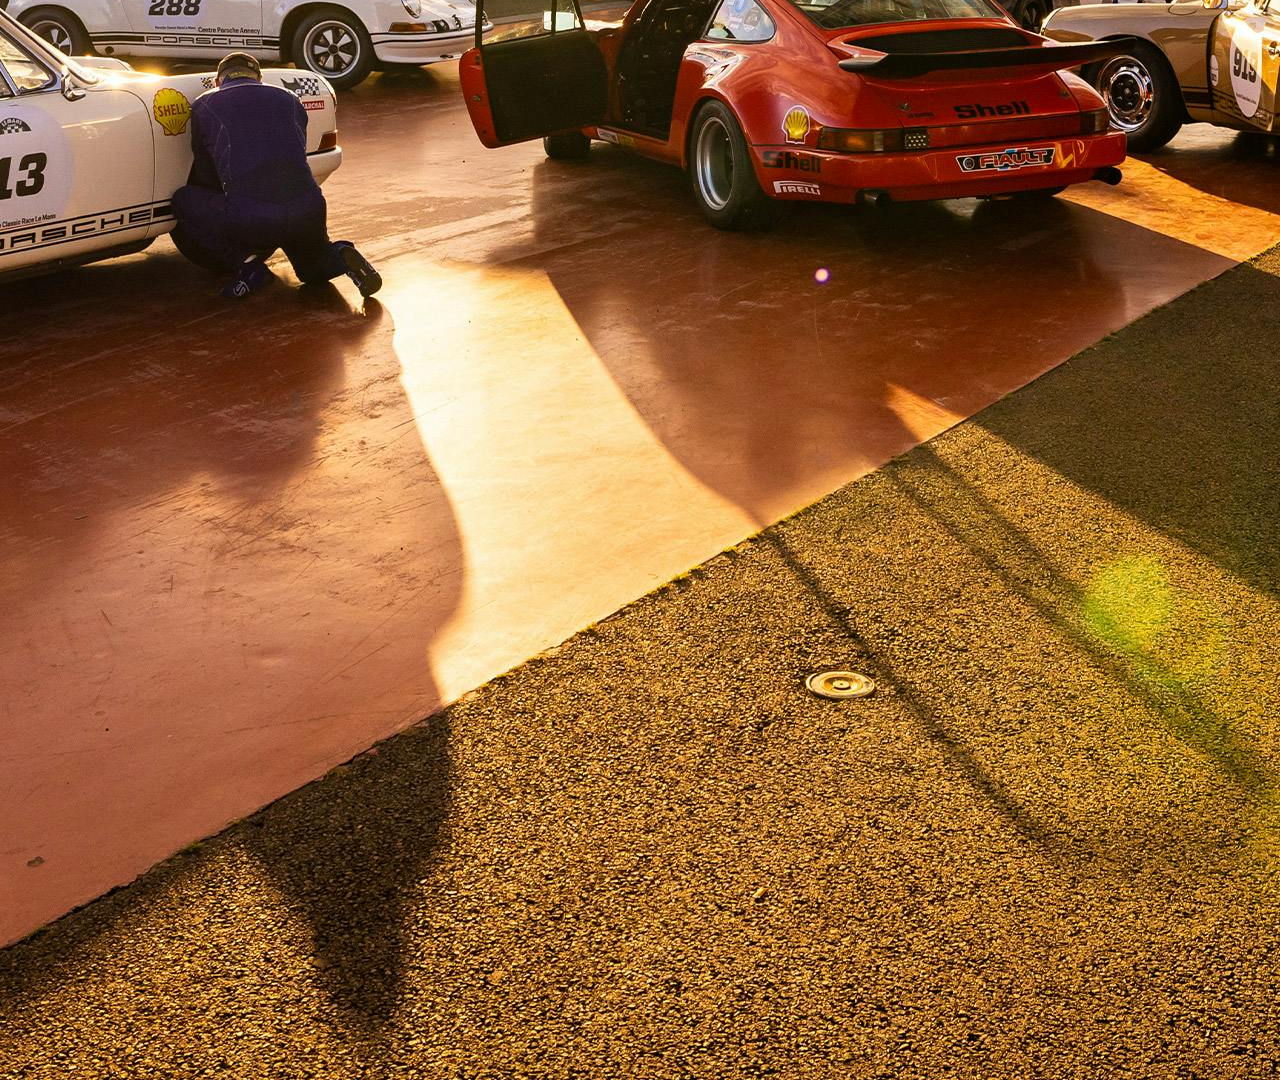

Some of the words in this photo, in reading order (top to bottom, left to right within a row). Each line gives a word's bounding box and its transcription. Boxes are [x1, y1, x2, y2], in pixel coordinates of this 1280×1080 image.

[240, 27, 261, 35] Annecy
[146, 35, 261, 46] PORSCHE
[157, 103, 187, 118] SHELL
[953, 100, 1031, 119] Shell
[762, 151, 821, 173] Shell
[980, 149, 1048, 168] FIAULT
[773, 180, 821, 196] PIRELLI
[2, 219, 21, 228] Classic
